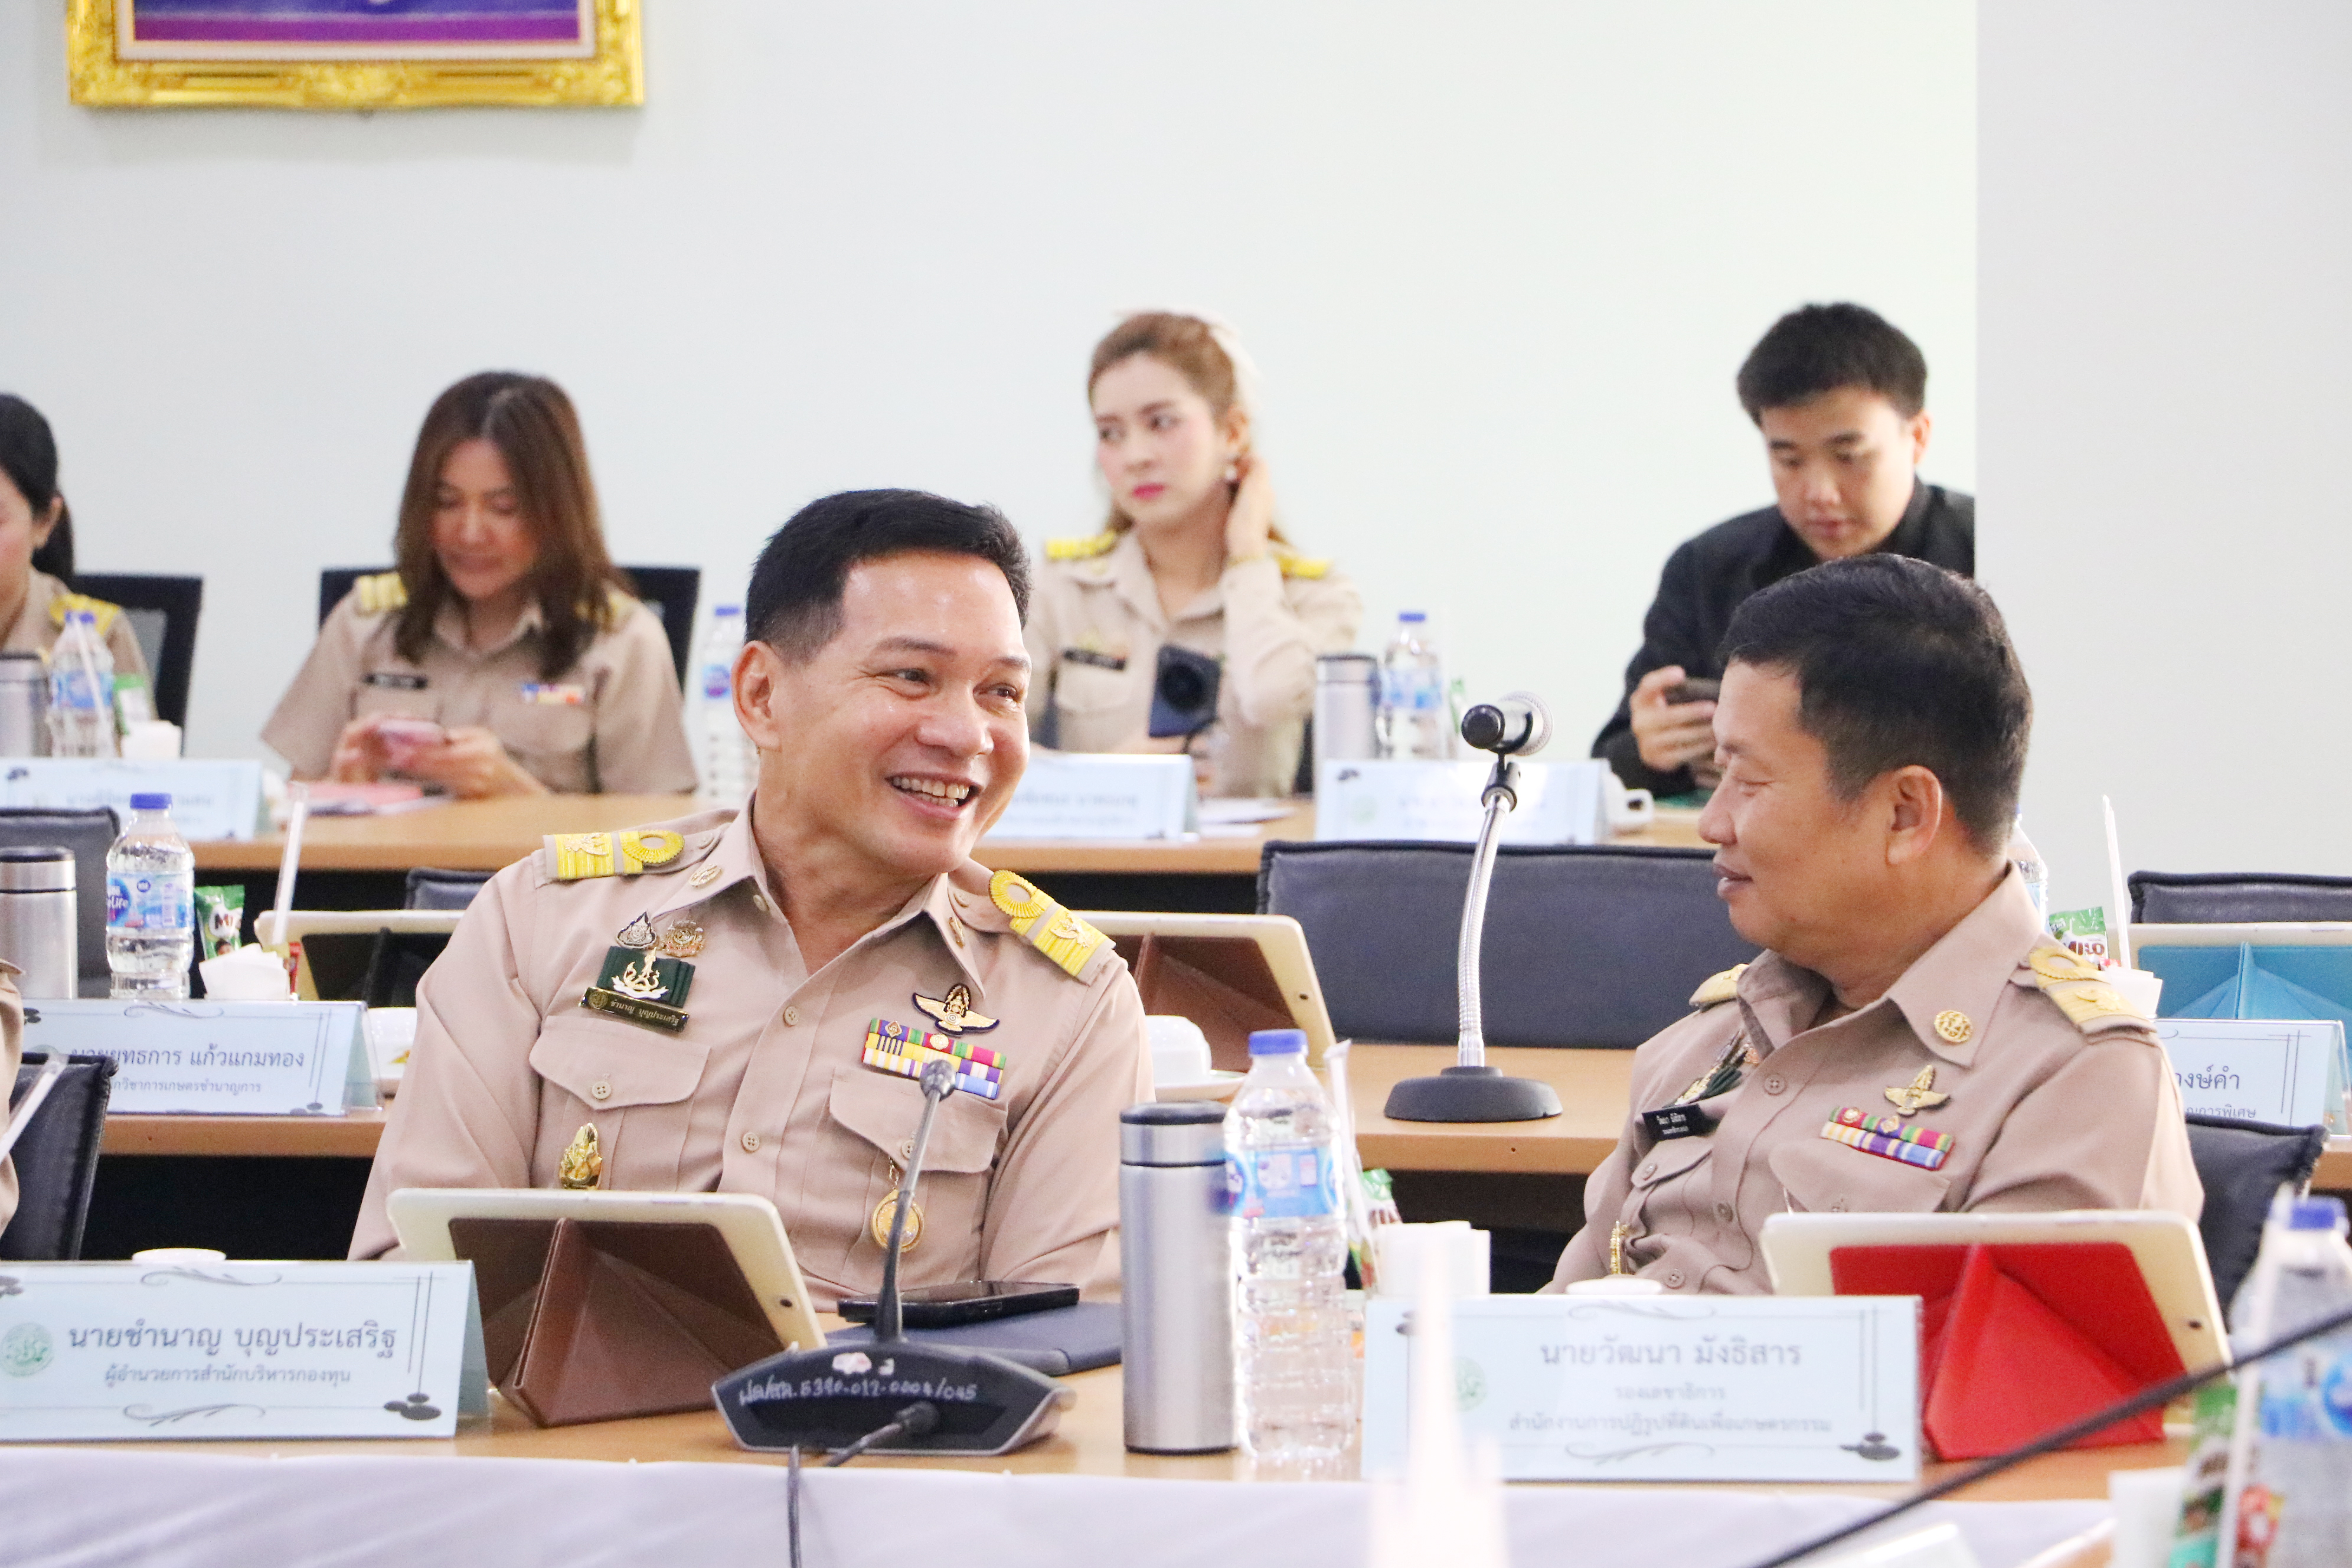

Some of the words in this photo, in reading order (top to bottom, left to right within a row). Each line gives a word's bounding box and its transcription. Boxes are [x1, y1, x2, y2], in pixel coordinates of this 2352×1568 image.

[71, 1049, 181, 1065] ยทธการ
[190, 1043, 305, 1067] แก้วแกมทอง
[112, 1077, 261, 1096] กวิชาการเกษตรชำนาญการ
[69, 1318, 221, 1356] นายชำนาญ
[234, 1319, 397, 1358] บุญประเสริฐ
[1540, 1334, 1681, 1365] นายวัฒนา
[1694, 1334, 1802, 1365] มังธิสาร
